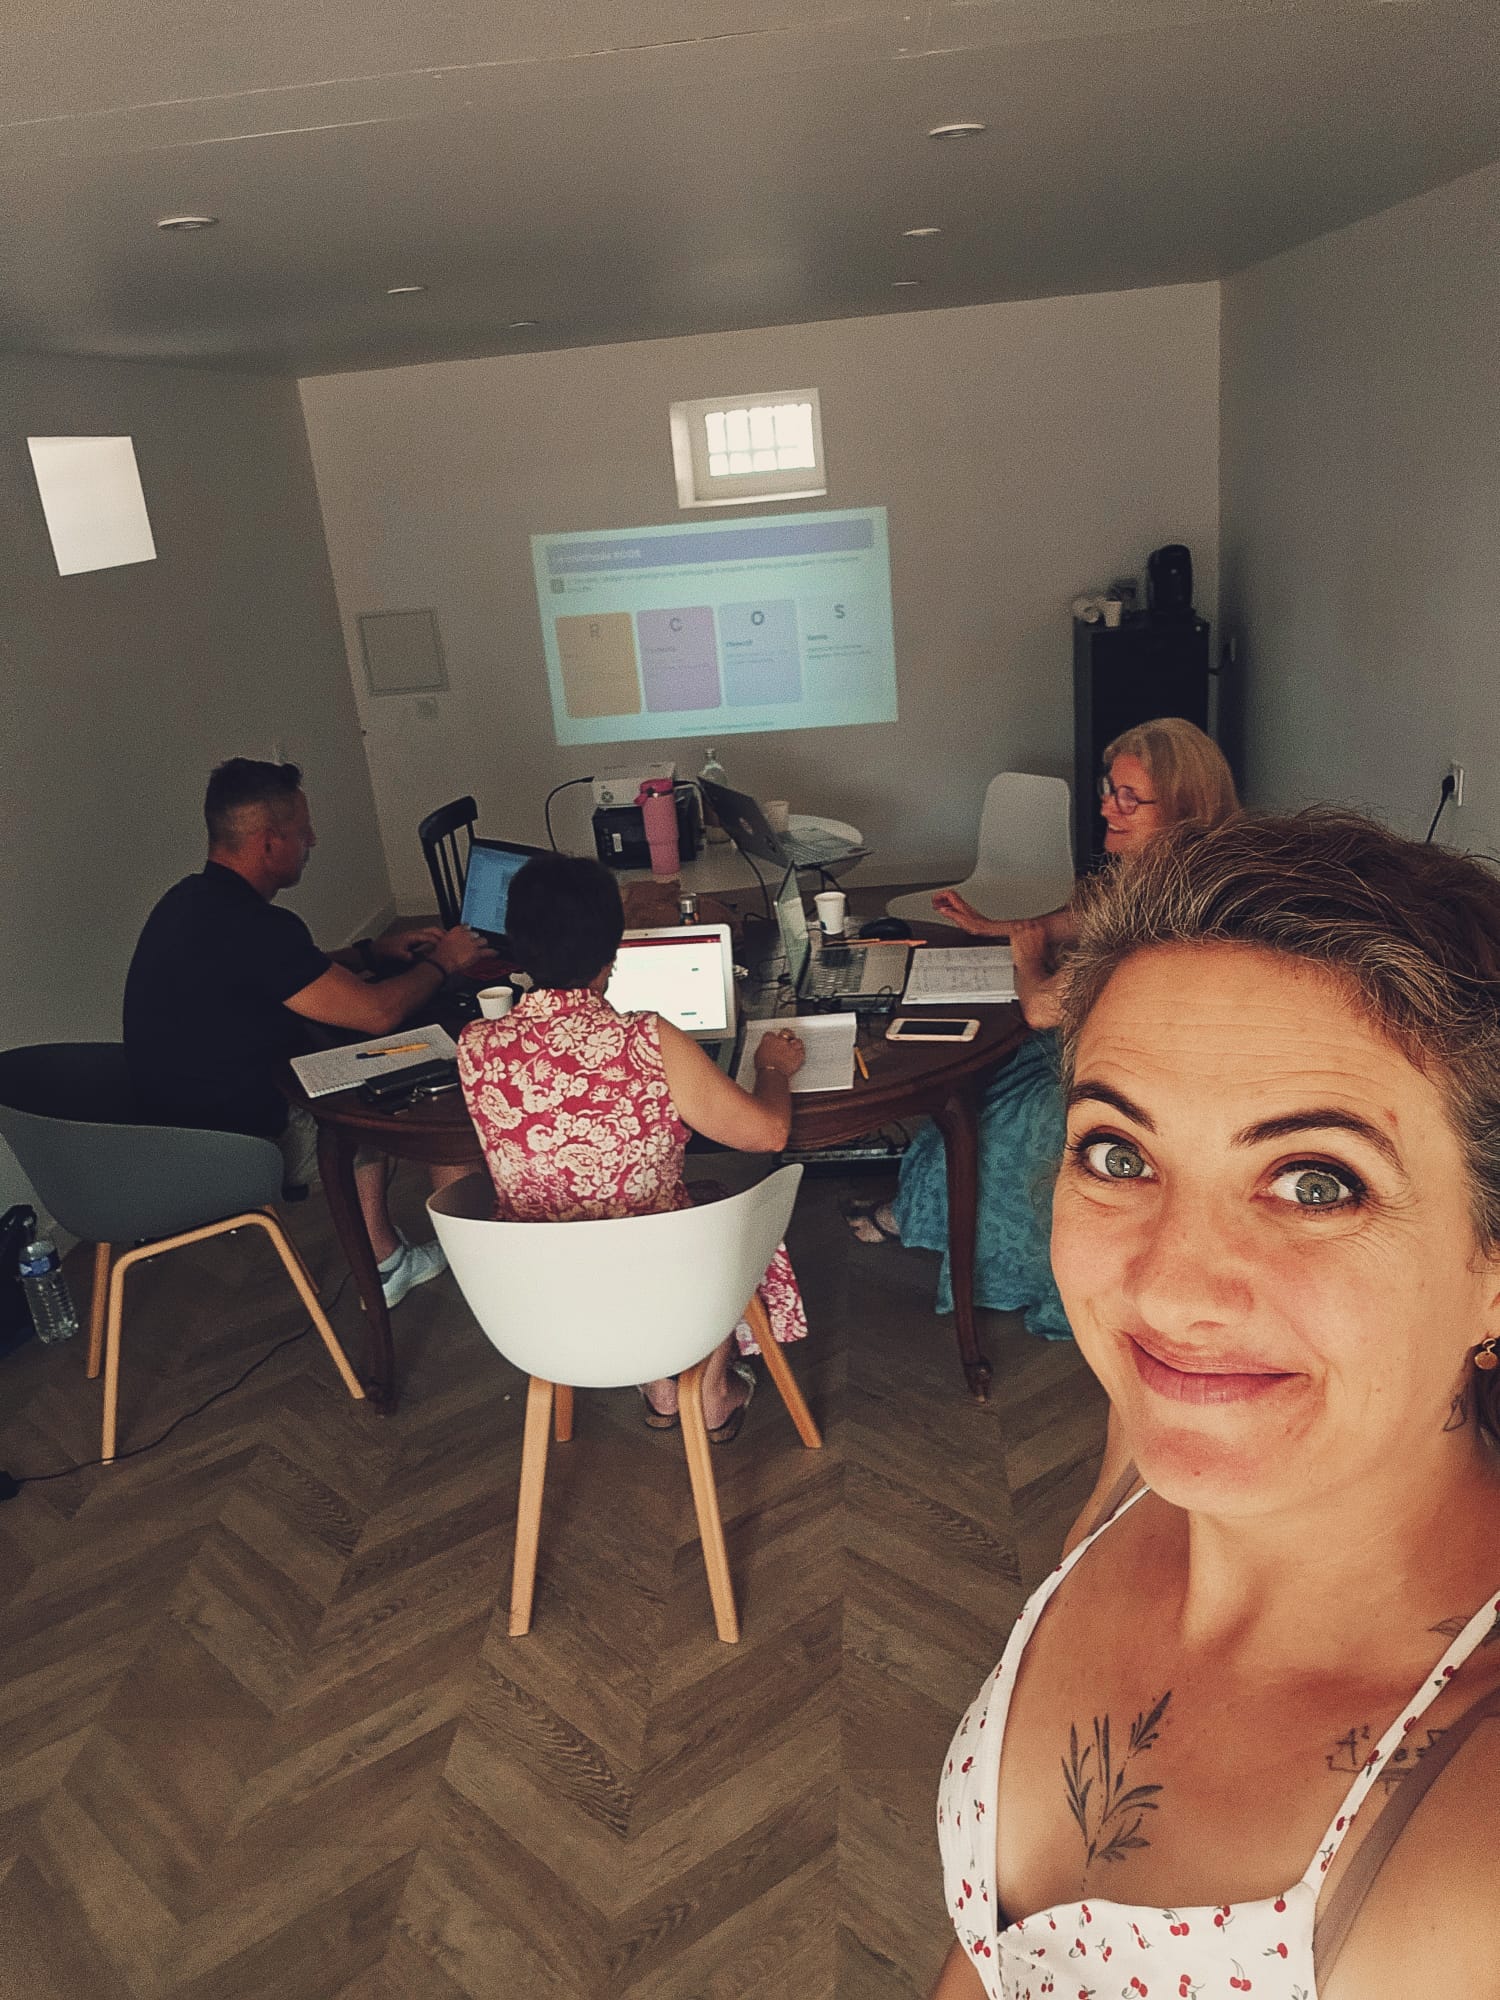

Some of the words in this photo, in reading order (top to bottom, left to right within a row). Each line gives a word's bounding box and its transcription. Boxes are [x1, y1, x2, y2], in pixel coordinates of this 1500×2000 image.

[750, 610, 765, 626] O
[833, 603, 846, 619] S
[589, 622, 601, 638] R
[669, 617, 682, 632] C
